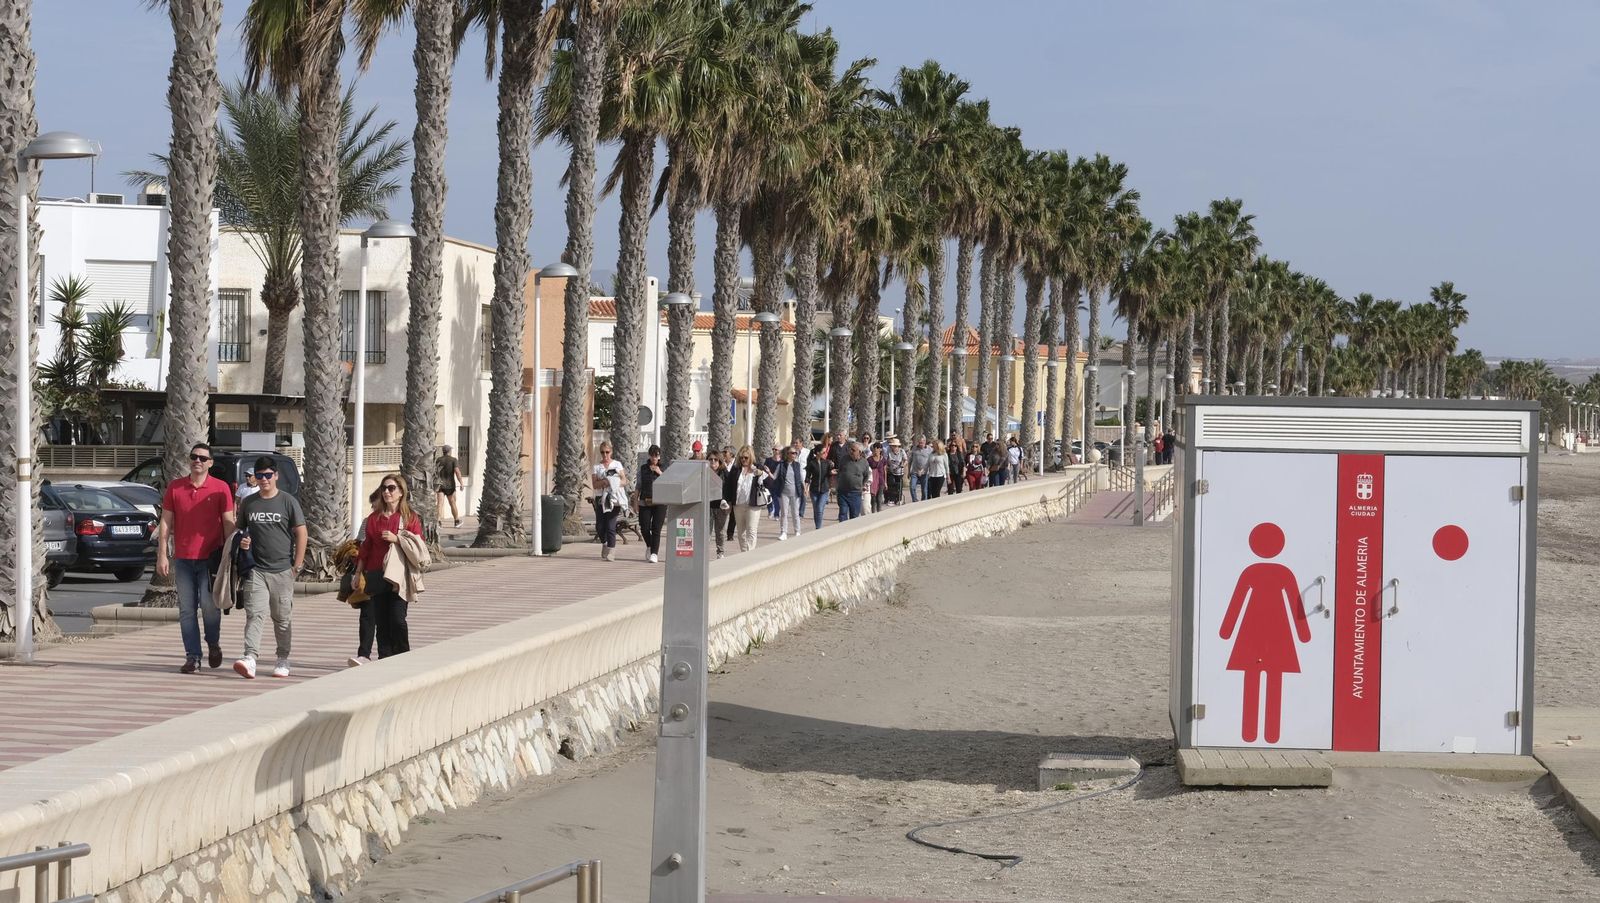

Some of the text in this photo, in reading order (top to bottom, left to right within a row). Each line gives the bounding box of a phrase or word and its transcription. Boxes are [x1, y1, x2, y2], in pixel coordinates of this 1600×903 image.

[679, 518, 691, 526] 44
[1352, 536, 1369, 699] AYUNTAMIENTO DE ALMERIA
